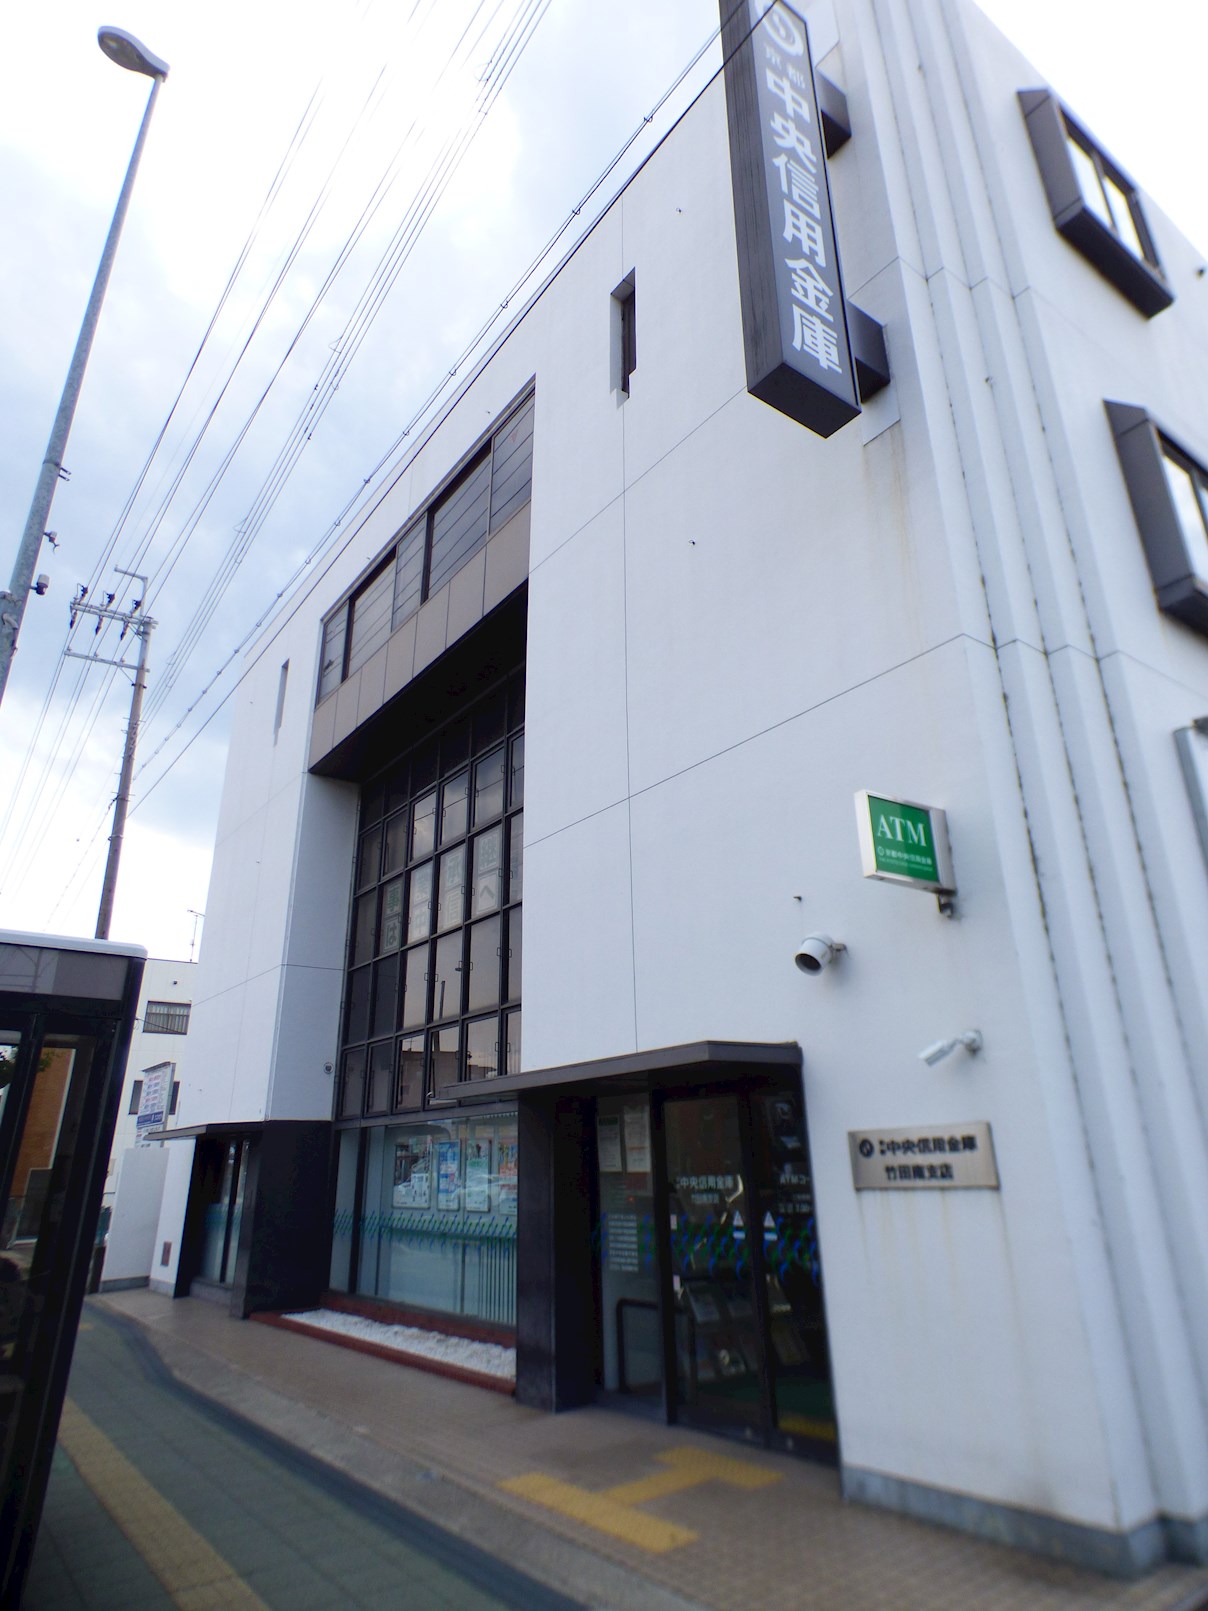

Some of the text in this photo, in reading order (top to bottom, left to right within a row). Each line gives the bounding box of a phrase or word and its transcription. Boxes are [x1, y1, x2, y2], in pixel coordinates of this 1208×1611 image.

[766, 67, 842, 374] 中央信用金庫
[877, 814, 927, 847] ATM
